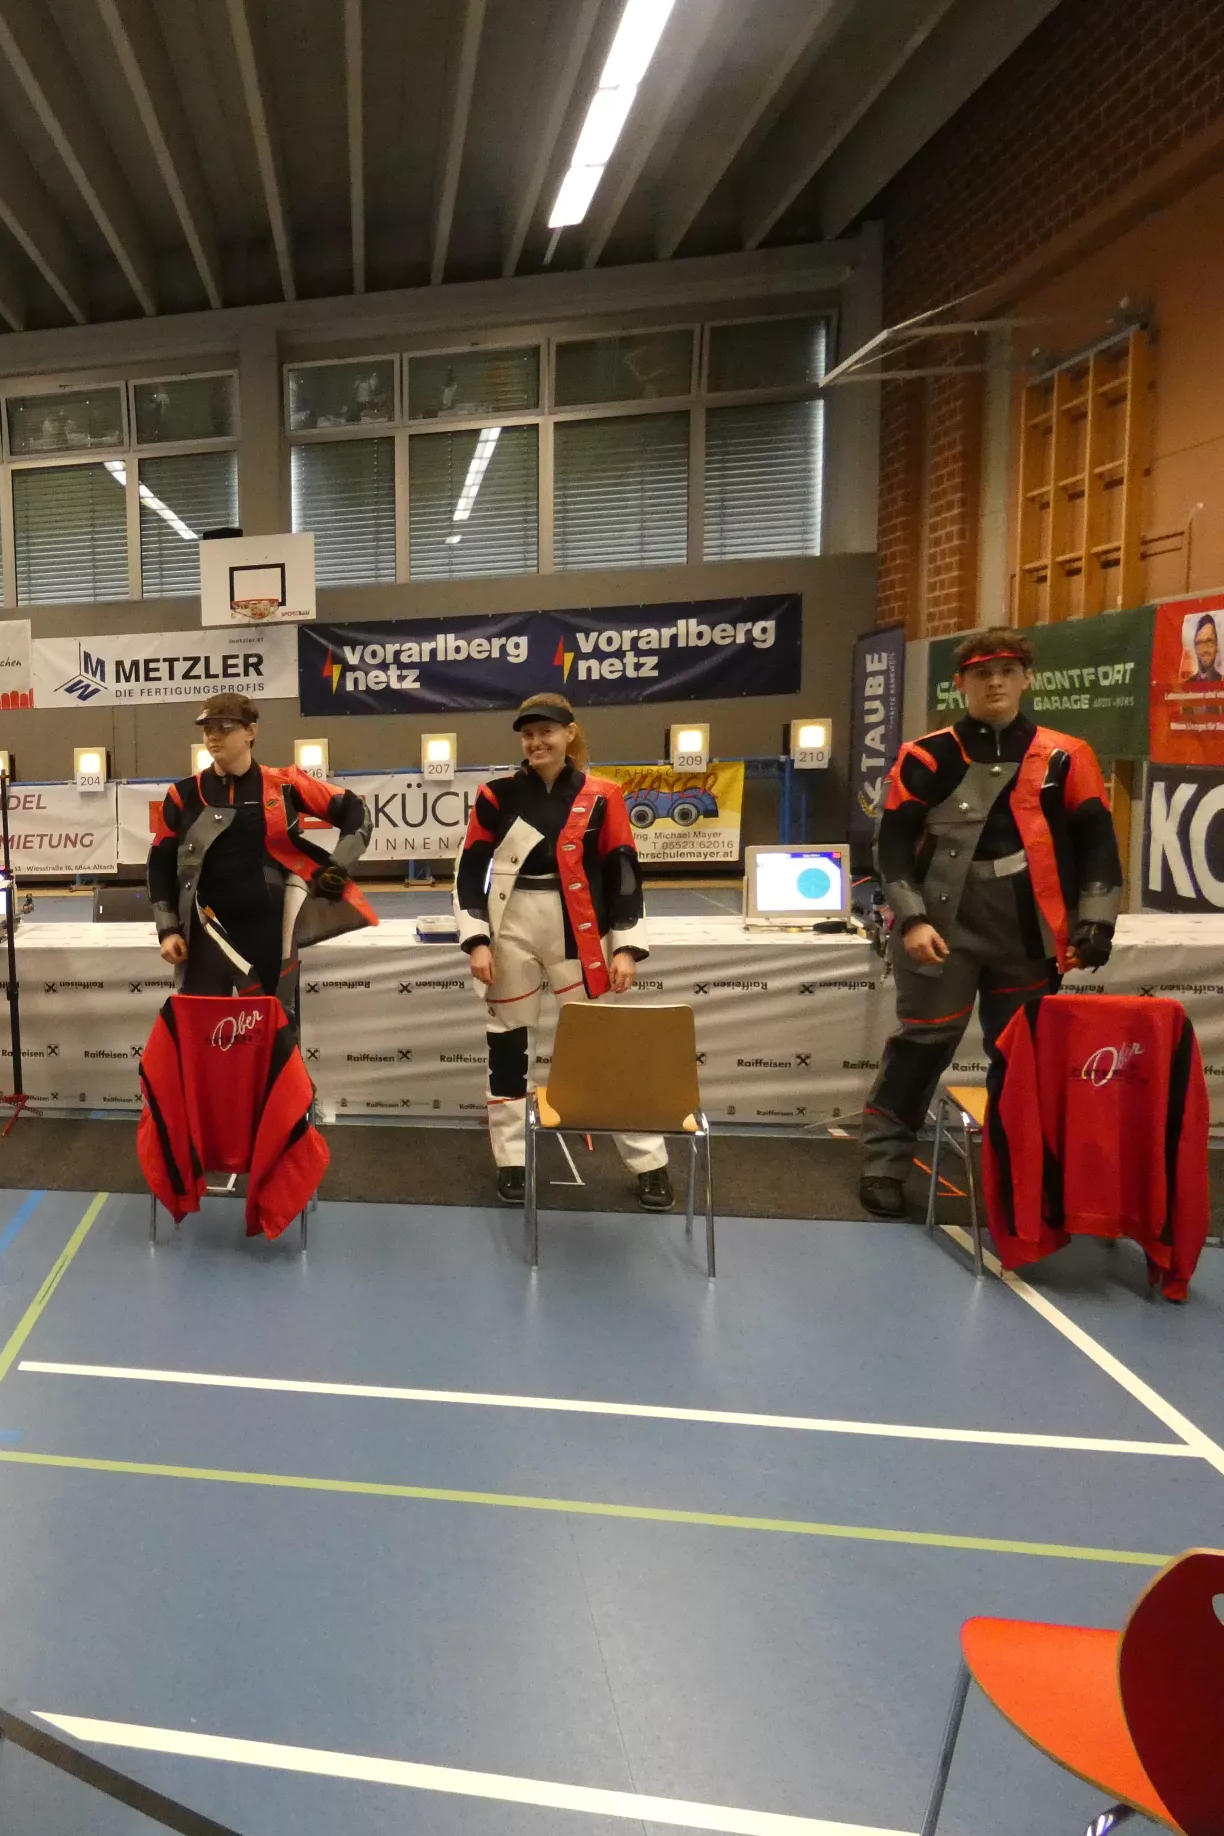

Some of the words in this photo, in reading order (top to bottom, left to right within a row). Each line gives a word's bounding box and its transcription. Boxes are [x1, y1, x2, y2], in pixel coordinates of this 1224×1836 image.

[576, 618, 776, 653] vorarlberg
[343, 633, 528, 664] vorarlberg
[115, 652, 264, 684] METZLER
[578, 651, 659, 680] netz
[346, 664, 421, 691] netz
[1031, 662, 1136, 692] MONTFORT
[115, 687, 134, 698] DIE
[140, 682, 265, 697] FERTIGUNGSPROFIS
[936, 680, 969, 711] SA
[1033, 694, 1090, 711] GARAGE
[861, 651, 888, 773] TAUBE
[678, 756, 703, 766] 209
[799, 751, 824, 762] 210
[428, 763, 450, 774] 207
[614, 766, 719, 778] FAHRSCE
[80, 776, 101, 786] 204
[633, 832, 651, 841] Ing.
[654, 831, 690, 840] Michael
[693, 831, 722, 840] Mayer
[637, 850, 733, 861] hrschulemayer.at
[93, 863, 115, 871] Altach
[59, 980, 104, 989] Raiffeisen
[144, 980, 176, 989] ffeisen
[322, 980, 371, 989] Raiffeisen
[415, 980, 464, 990] Raiffeisen
[713, 980, 768, 992] Raiffeisen
[818, 981, 876, 992] Raiffeisen
[84, 1050, 128, 1059] Raiffeisen
[346, 1053, 395, 1063] Raiffeisen
[736, 1058, 792, 1069] Raiffeisen
